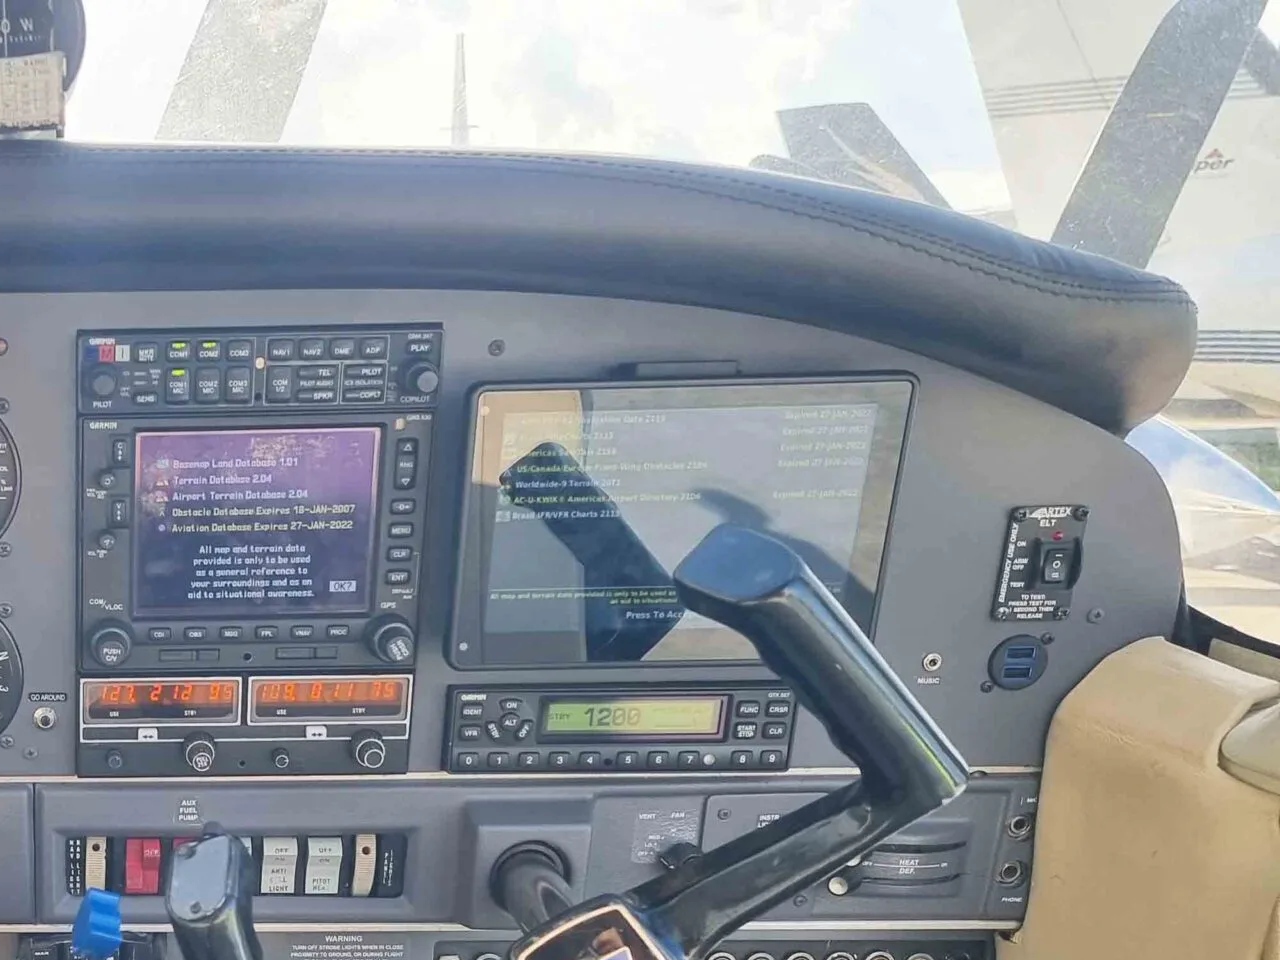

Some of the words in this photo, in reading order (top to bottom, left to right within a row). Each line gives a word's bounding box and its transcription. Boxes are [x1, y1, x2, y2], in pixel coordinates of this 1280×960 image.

[20, 18, 34, 32] W
[90, 422, 117, 430] GARMIN
[173, 460, 210, 469] Basemap
[212, 460, 234, 468] Land
[235, 459, 276, 467] Database
[279, 458, 298, 466] 1.01
[174, 477, 207, 485] Terrain
[209, 476, 250, 484] Database
[252, 475, 271, 483] 2.04
[172, 492, 205, 501] Airport
[210, 491, 244, 500] Terrain
[245, 491, 286, 499] Database
[288, 490, 308, 498] 2.04
[172, 508, 211, 517] Obstacle
[213, 507, 254, 516] Database
[256, 507, 290, 515] Expires
[294, 504, 355, 514] 18-JAN-2007
[172, 524, 209, 532] Aviation
[211, 524, 252, 532] Database
[254, 523, 288, 531] Expires
[290, 521, 353, 530] 27-JAN-2022
[1010, 523, 1019, 542] ONLY
[215, 547, 230, 555] map
[233, 545, 248, 553] and
[286, 544, 305, 552] data
[1007, 542, 1015, 558] USE
[193, 557, 231, 566] provided
[245, 556, 263, 565] only
[216, 568, 248, 577] general
[251, 567, 295, 575] reference
[191, 580, 210, 588] your
[213, 579, 269, 588] surroundings
[272, 578, 287, 586] and
[333, 582, 352, 590] OK?
[999, 559, 1011, 602] EMERGENCY
[188, 591, 201, 599] aid
[216, 589, 265, 598] situational
[268, 589, 314, 597] awareness.
[626, 611, 650, 620] Press
[653, 611, 664, 619] To
[584, 708, 641, 727] 1200
